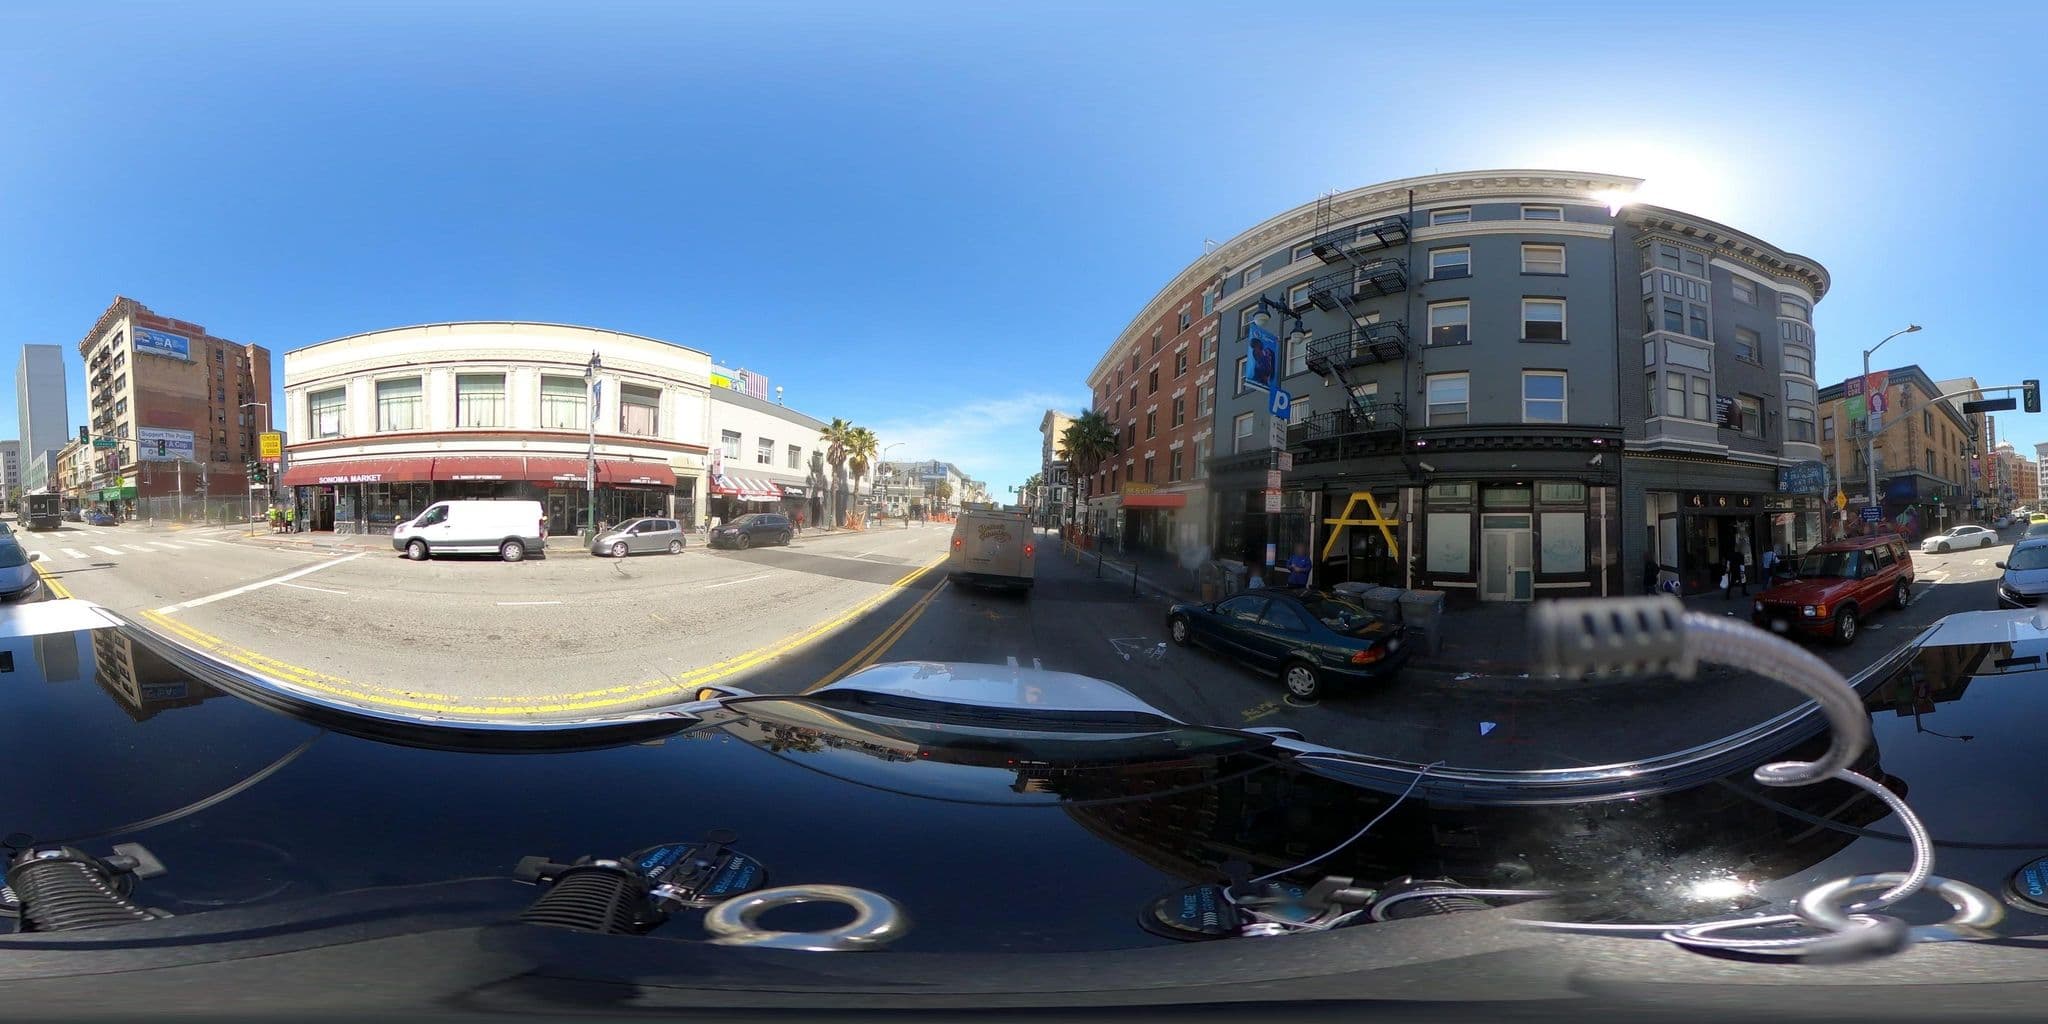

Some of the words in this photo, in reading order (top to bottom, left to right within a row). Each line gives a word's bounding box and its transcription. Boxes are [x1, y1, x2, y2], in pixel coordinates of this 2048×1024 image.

[164, 338, 172, 348] A
[318, 476, 348, 484] SONOMA
[350, 474, 381, 483] MARKET
